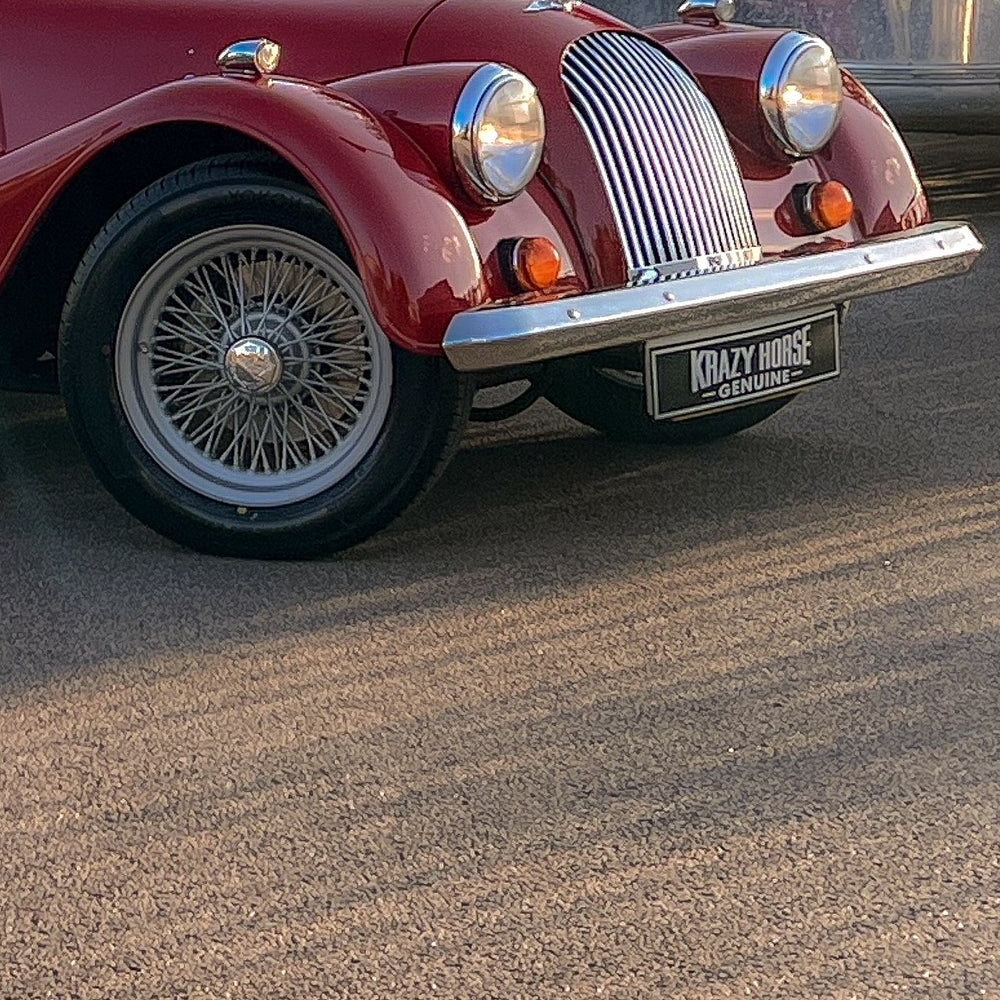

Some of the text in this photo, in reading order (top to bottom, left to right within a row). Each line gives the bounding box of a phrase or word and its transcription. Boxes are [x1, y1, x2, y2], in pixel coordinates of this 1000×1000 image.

[690, 325, 812, 394] KRAZY HORSE
[717, 369, 791, 399] GENUINE
